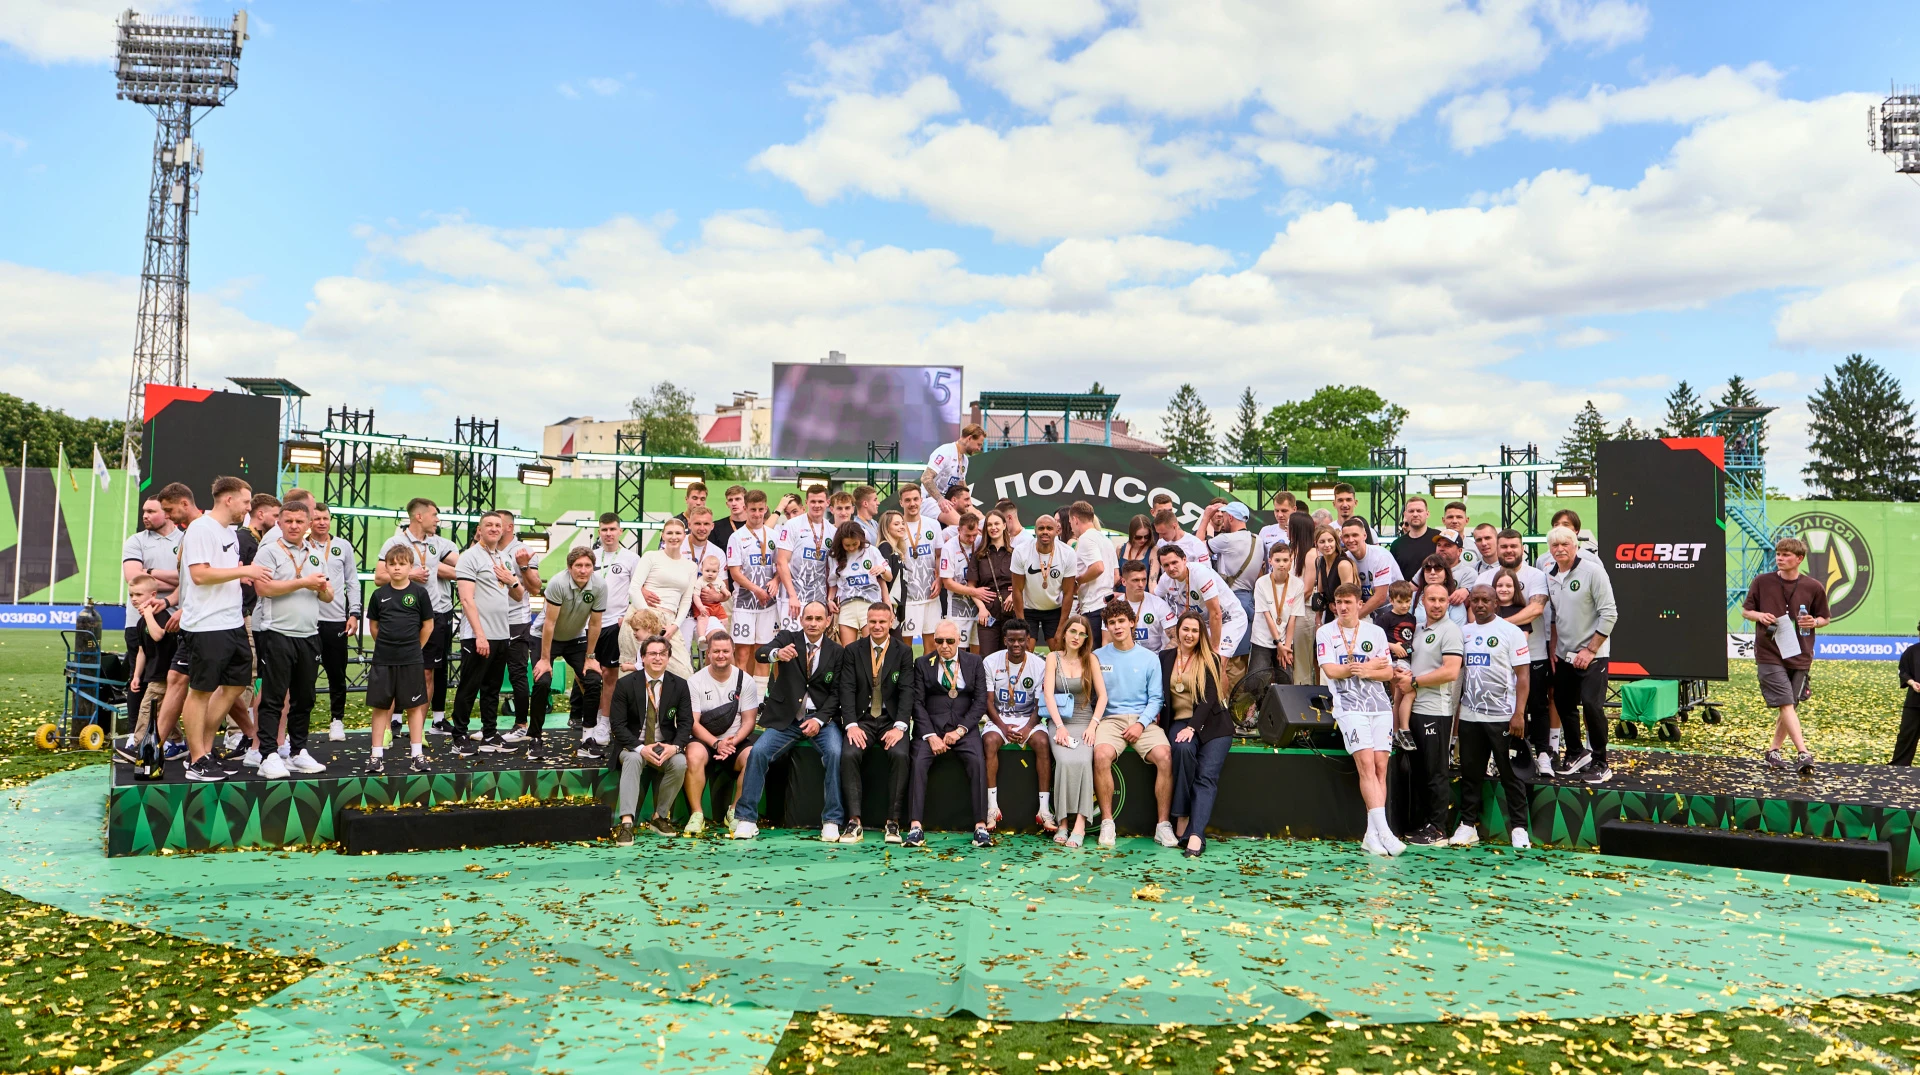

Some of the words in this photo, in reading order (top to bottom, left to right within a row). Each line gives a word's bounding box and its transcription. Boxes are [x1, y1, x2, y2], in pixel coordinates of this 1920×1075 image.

[1783, 517, 1856, 542] ОЛІССЯ
[849, 576, 867, 586] BGV
[733, 623, 750, 638] 88
[782, 617, 799, 631] 95
[1820, 643, 1892, 655] МОРОЗИВО
[1467, 655, 1488, 665] BGV
